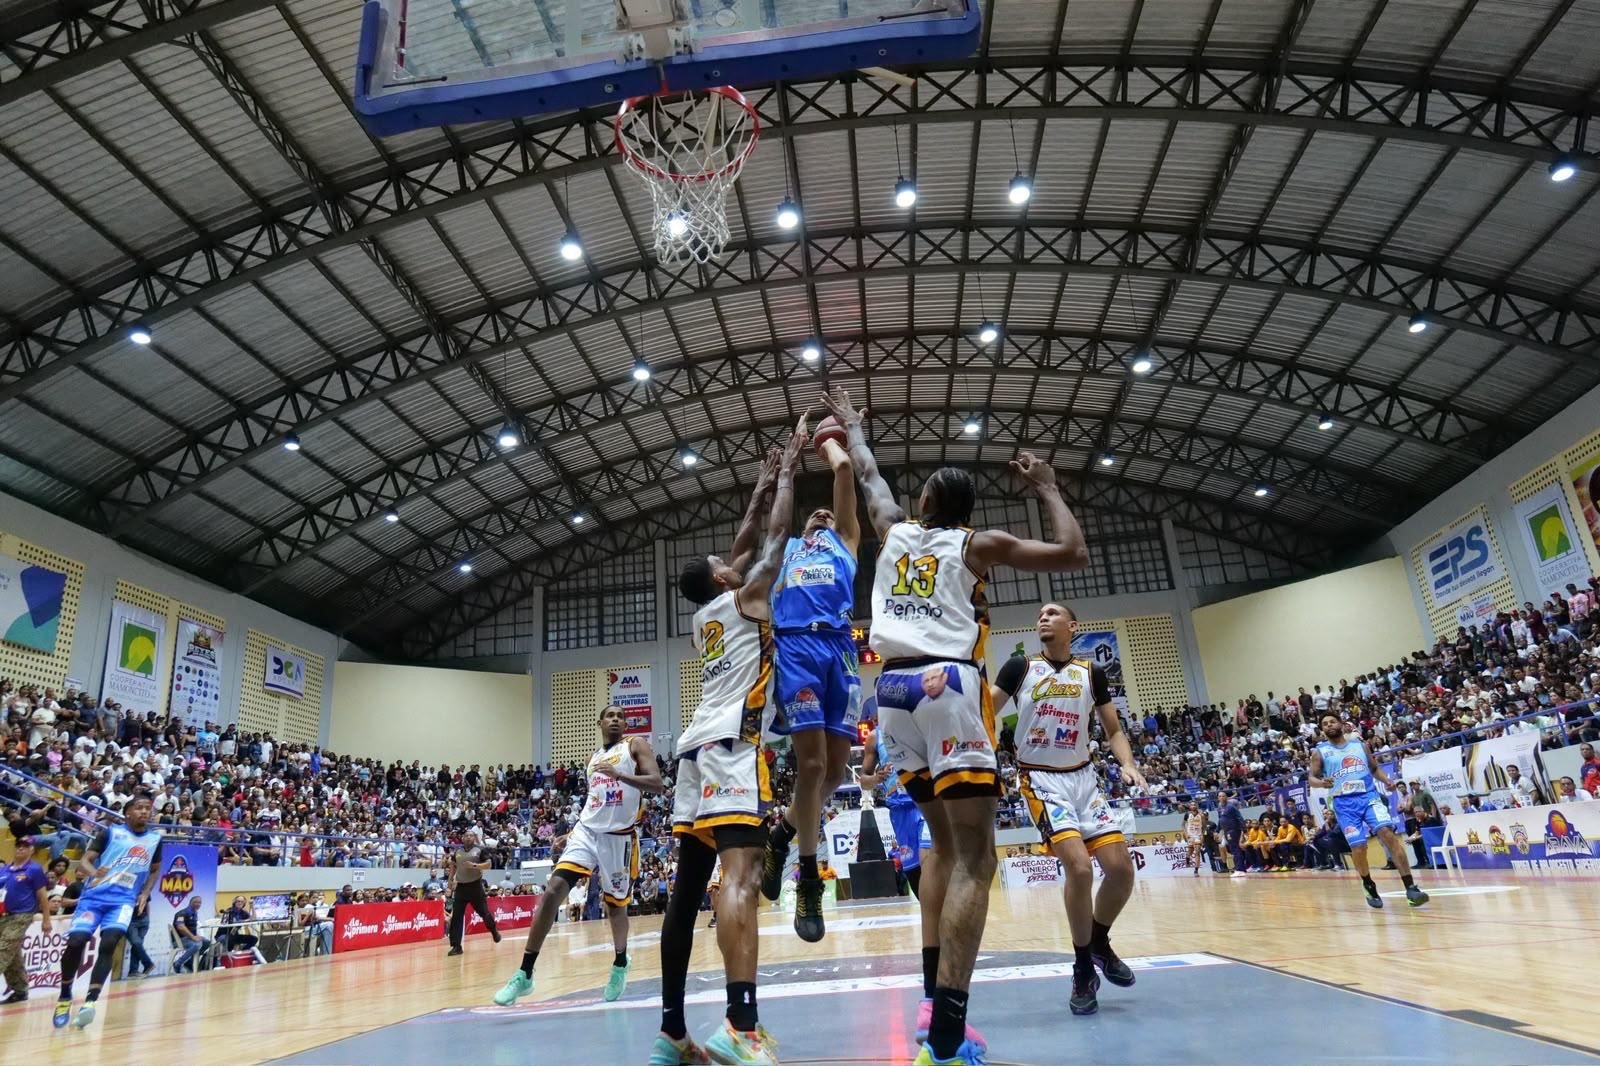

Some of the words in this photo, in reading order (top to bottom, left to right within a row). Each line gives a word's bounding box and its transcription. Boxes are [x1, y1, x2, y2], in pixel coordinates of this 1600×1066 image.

[1429, 525, 1489, 591] EPS
[891, 552, 939, 599] 13
[621, 675, 640, 685] AM
[621, 698, 649, 706] PINTURAS
[1041, 708, 1080, 720] primera
[1154, 846, 1188, 856] AGREGAD
[1011, 859, 1056, 868] AGREGADOS
[1022, 866, 1057, 874] LINIEROS
[161, 877, 193, 893] MAO
[351, 924, 379, 937] primera
[388, 920, 412, 932] primera
[21, 933, 68, 950] GADOS
[26, 971, 63, 986] PORTE
